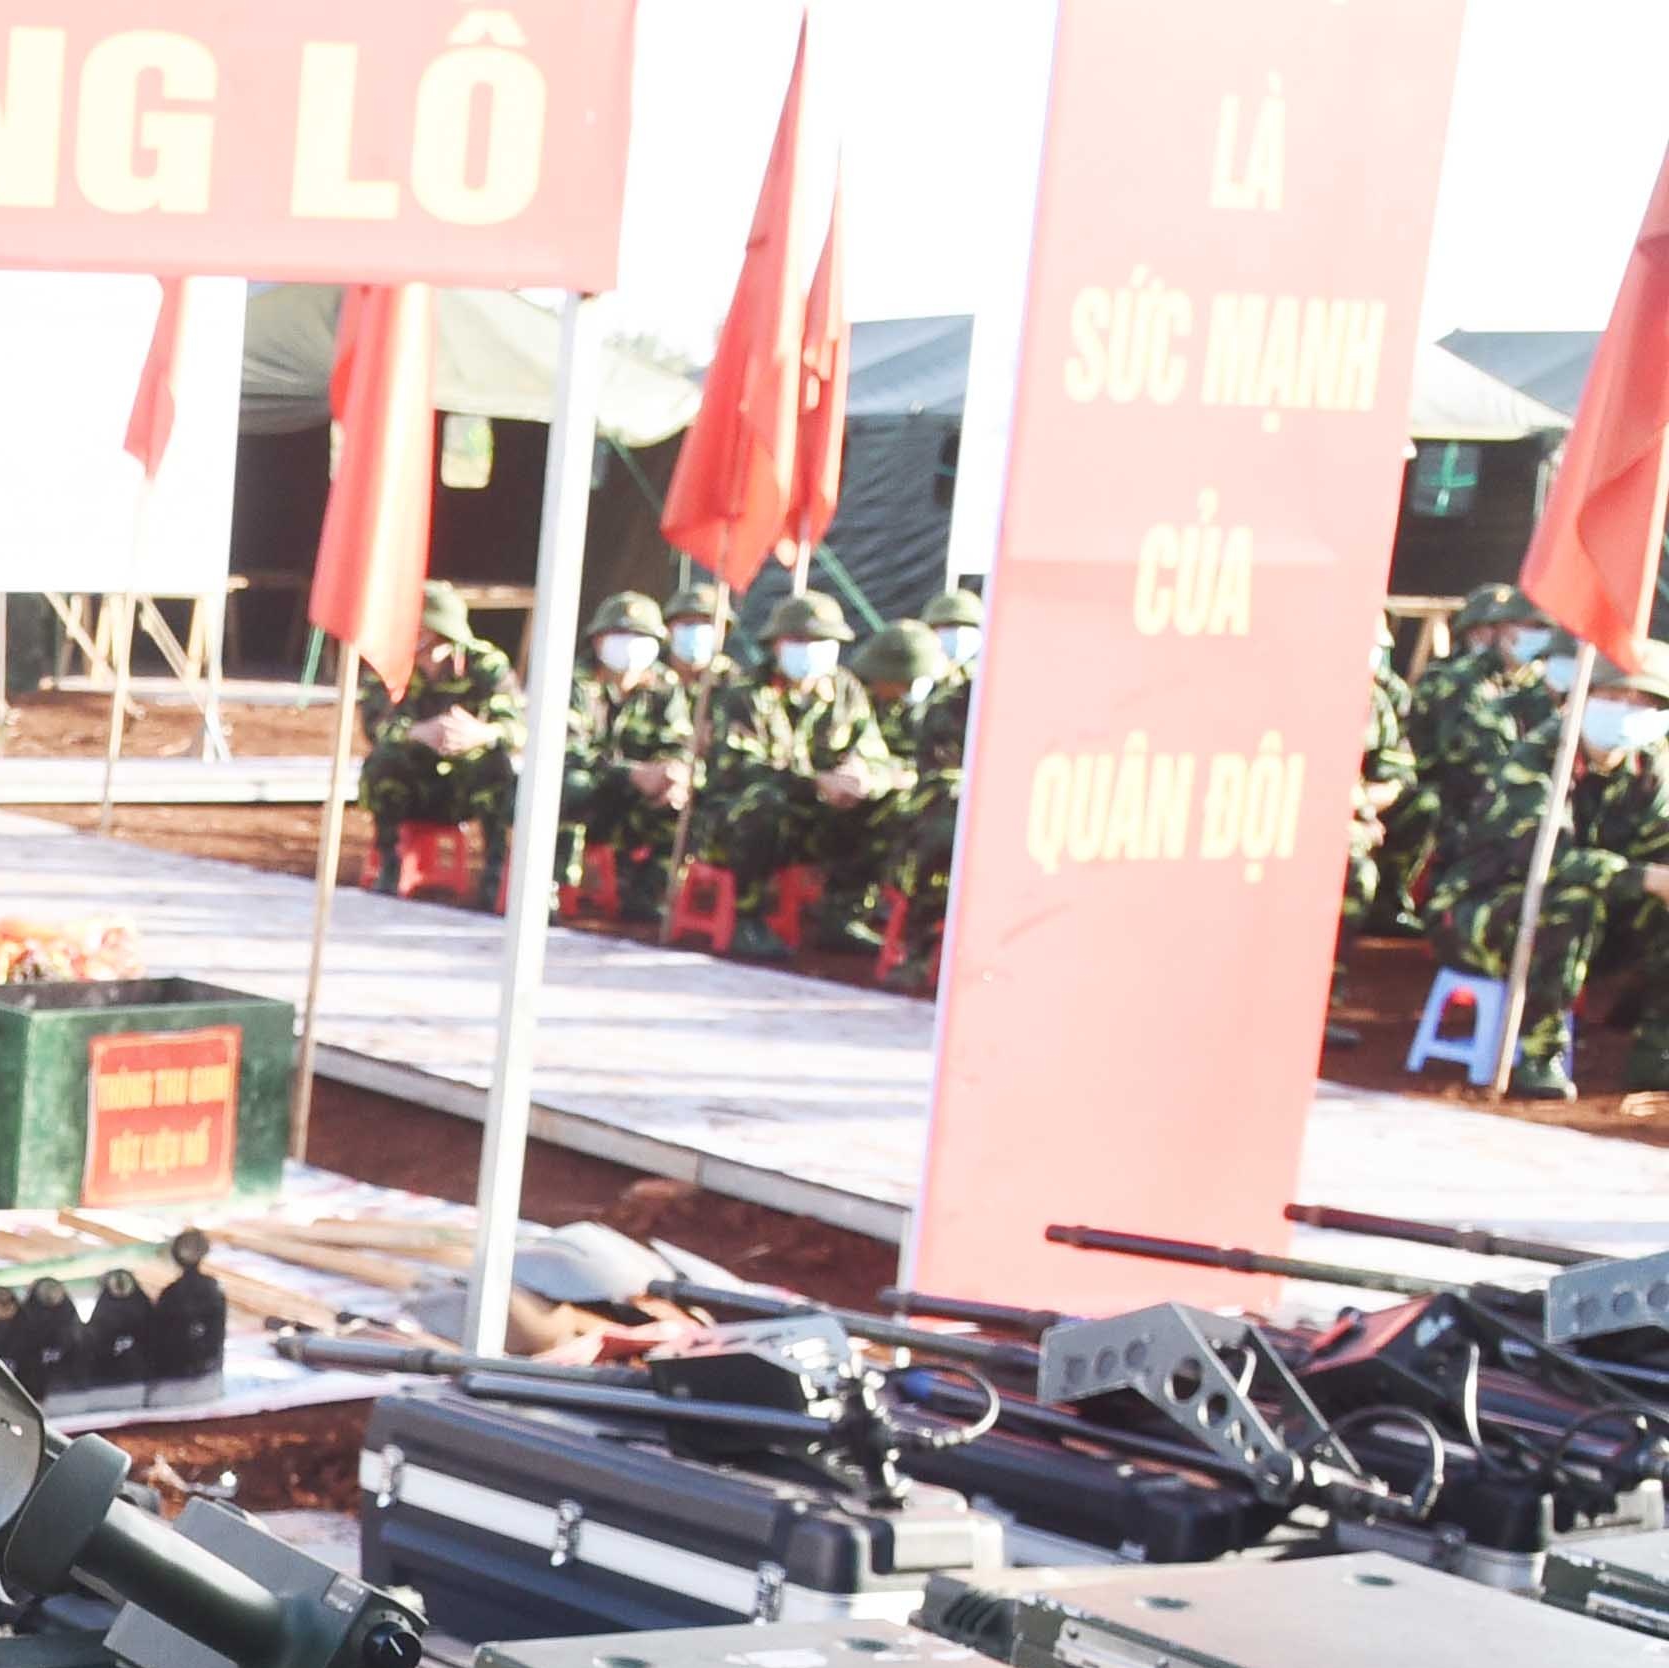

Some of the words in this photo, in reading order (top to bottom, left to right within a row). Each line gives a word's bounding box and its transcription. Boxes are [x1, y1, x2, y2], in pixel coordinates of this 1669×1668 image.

[1210, 66, 1285, 211] LÀ
[1064, 262, 1193, 406] SỨC
[1201, 290, 1387, 433] MẠNH
[1134, 487, 1253, 637] CỦA
[1026, 730, 1195, 875] QUÂN
[1200, 730, 1305, 883] ĐỘI
